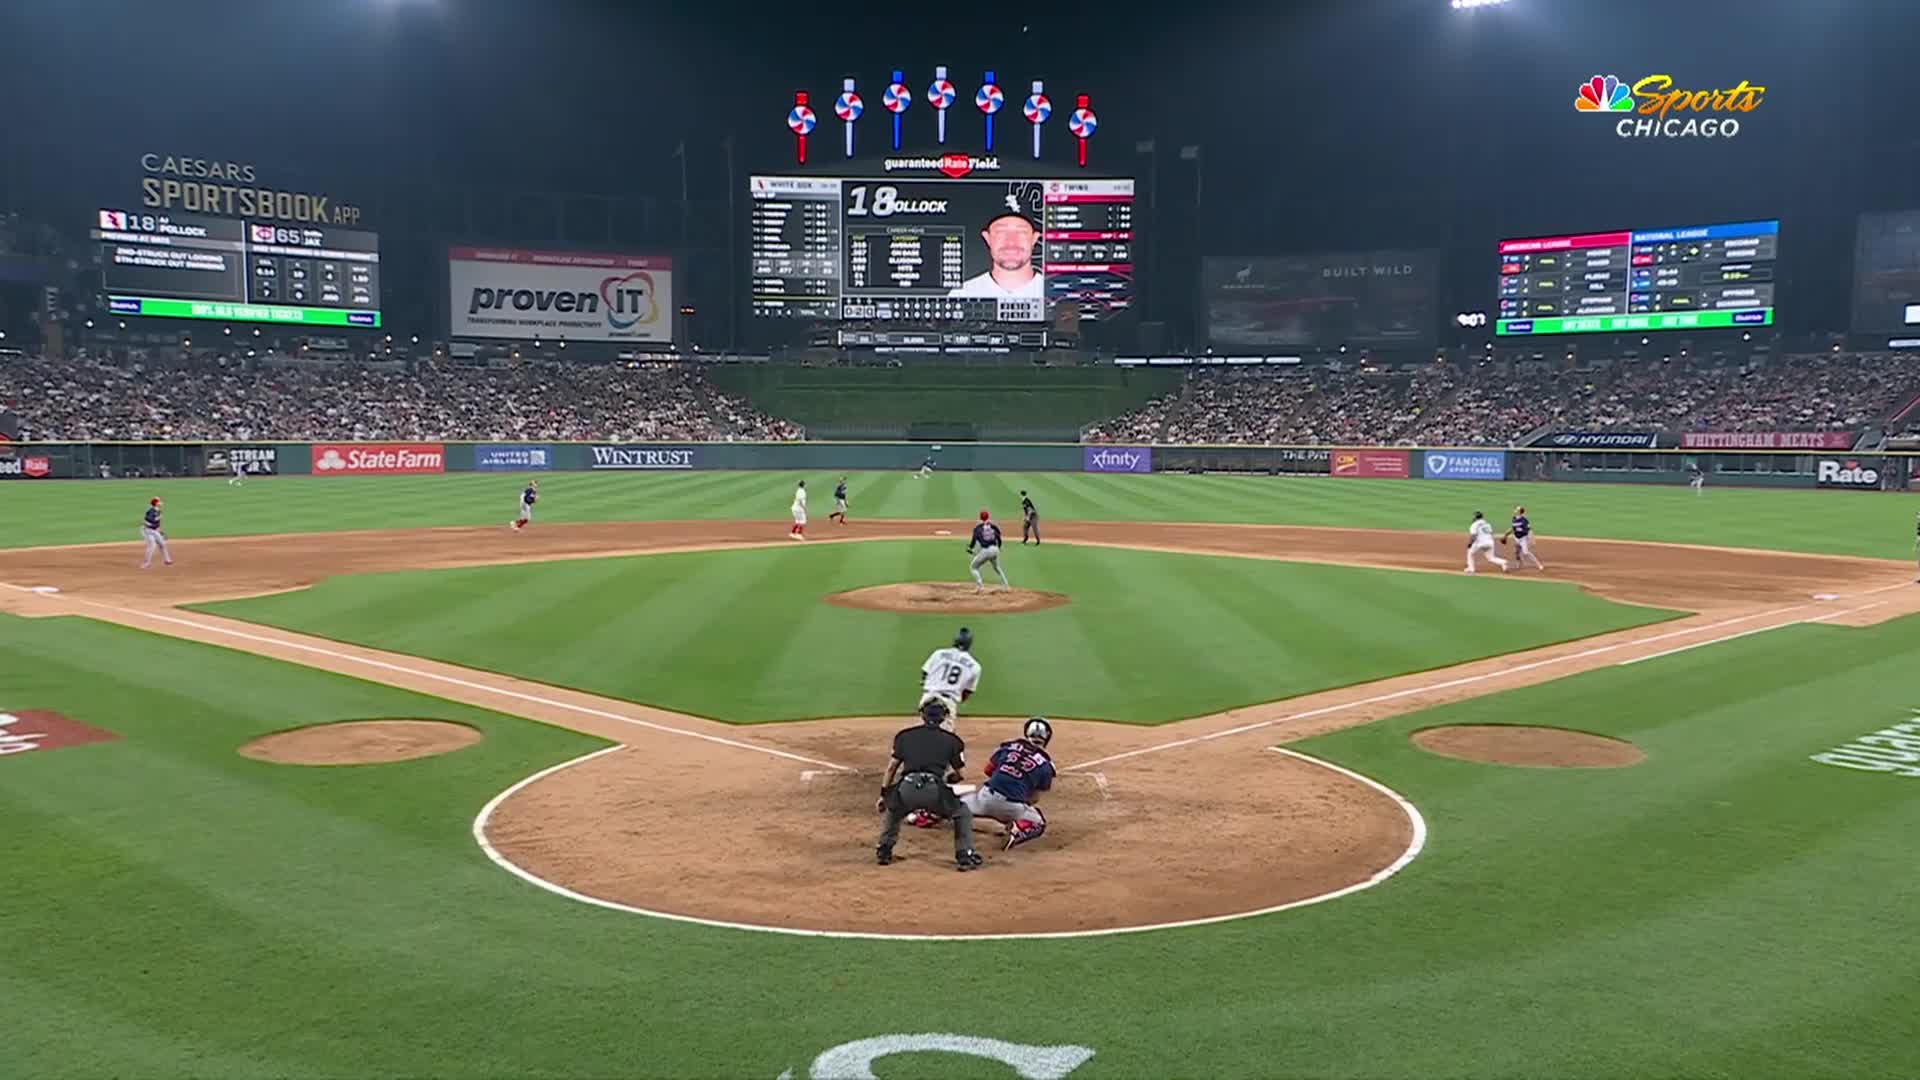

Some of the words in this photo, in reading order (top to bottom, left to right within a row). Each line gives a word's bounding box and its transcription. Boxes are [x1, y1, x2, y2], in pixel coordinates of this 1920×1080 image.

[141, 153, 256, 183] CAESARS
[884, 157, 943, 171] guaranteed
[944, 157, 967, 169] Rate
[142, 177, 329, 223] SPORTSBOOK
[333, 206, 360, 225] APP
[847, 186, 898, 216] 18
[893, 199, 948, 213] OLLOCK
[129, 215, 155, 231] 18
[159, 224, 207, 237] POLLOCK
[276, 228, 301, 244] 65
[304, 238, 322, 247] JAX
[1634, 232, 1673, 242] NATIONAL
[1676, 228, 1708, 240] LEAGUE
[1323, 266, 1367, 278] BUILT
[1374, 264, 1413, 276] WILD
[468, 286, 599, 314] proven
[616, 288, 644, 314] IT
[1578, 434, 1649, 446] HYUNDAI
[1684, 432, 1774, 447] WHITTINGHAM
[1780, 433, 1825, 447] MEATS
[230, 449, 275, 461] STREAM
[592, 446, 694, 464] WINTRUST
[1092, 449, 1140, 469] xfinity
[1281, 450, 1305, 460] THE
[1448, 456, 1500, 467] FANDUEL
[1818, 460, 1878, 485] Rate
[940, 663, 962, 685] 18
